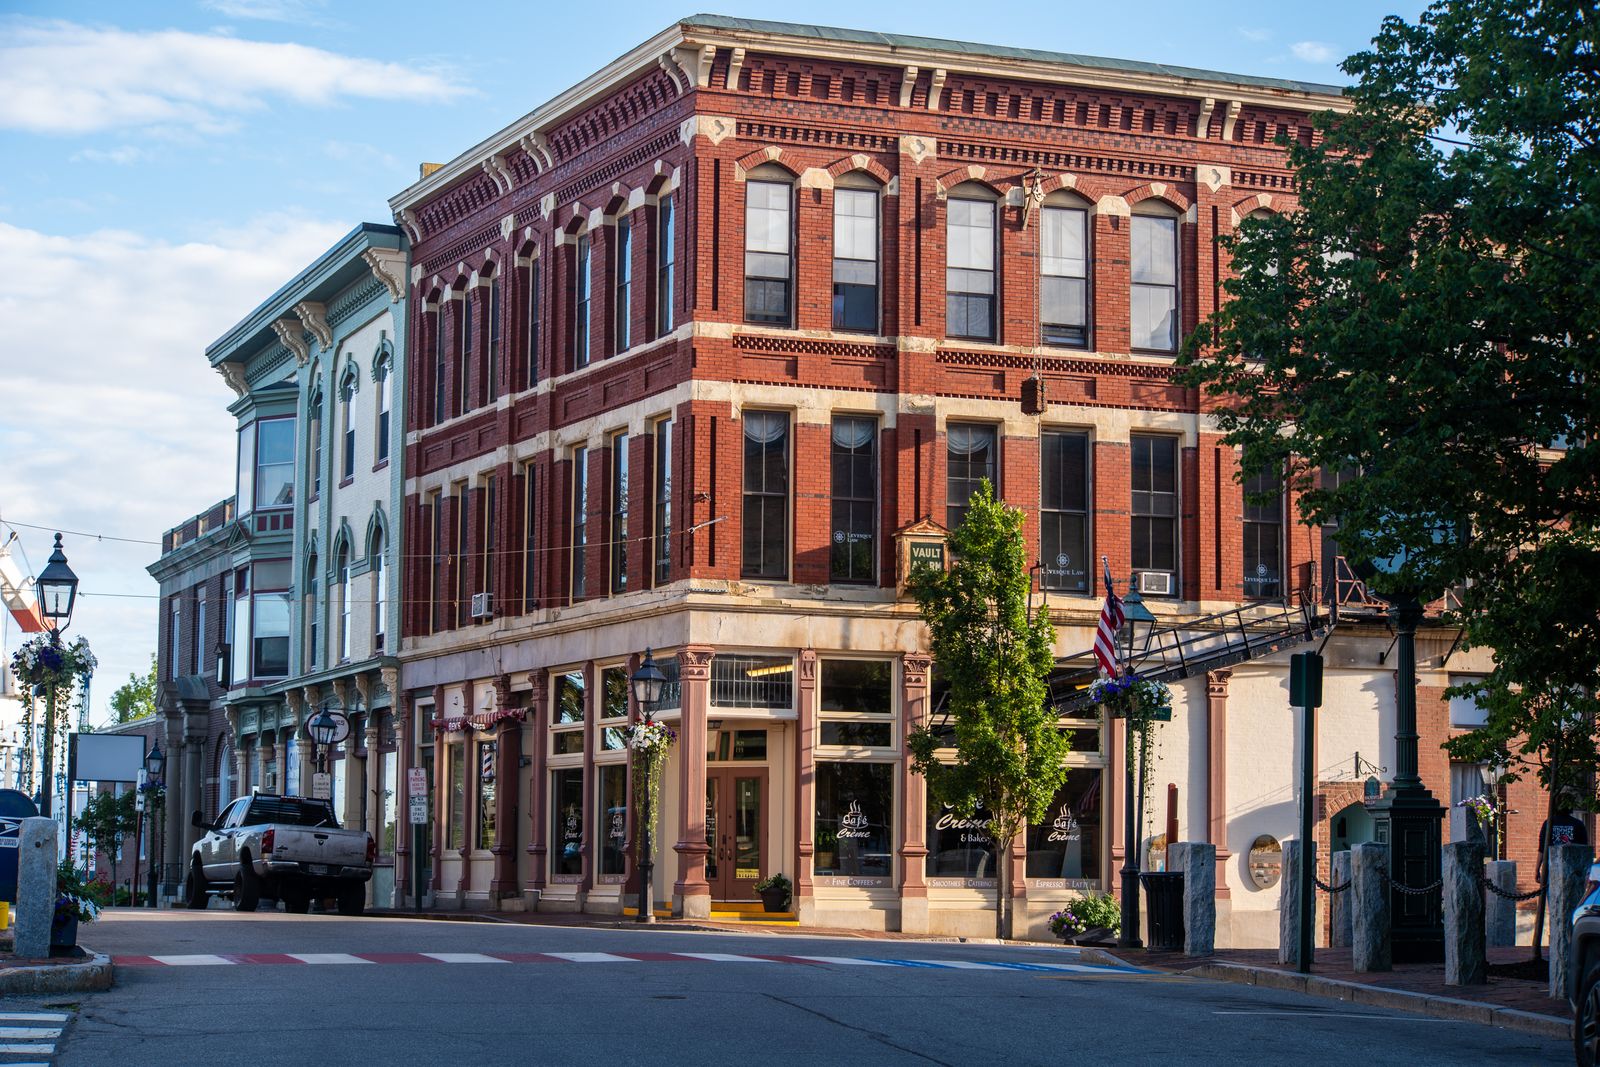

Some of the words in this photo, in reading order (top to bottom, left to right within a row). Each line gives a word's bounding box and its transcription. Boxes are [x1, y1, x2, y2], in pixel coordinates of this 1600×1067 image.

[912, 547, 942, 558] VAULT
[911, 560, 942, 571] ARM
[843, 815, 868, 828] Café
[1053, 818, 1078, 832] Café
[836, 828, 871, 839] Crème
[960, 833, 967, 843] &
[1047, 831, 1081, 842] Crème
[832, 878, 846, 886] FINE
[847, 878, 874, 886] COFFEES
[967, 879, 992, 887] CATERING
[1035, 879, 1064, 888] ESPRESSO
